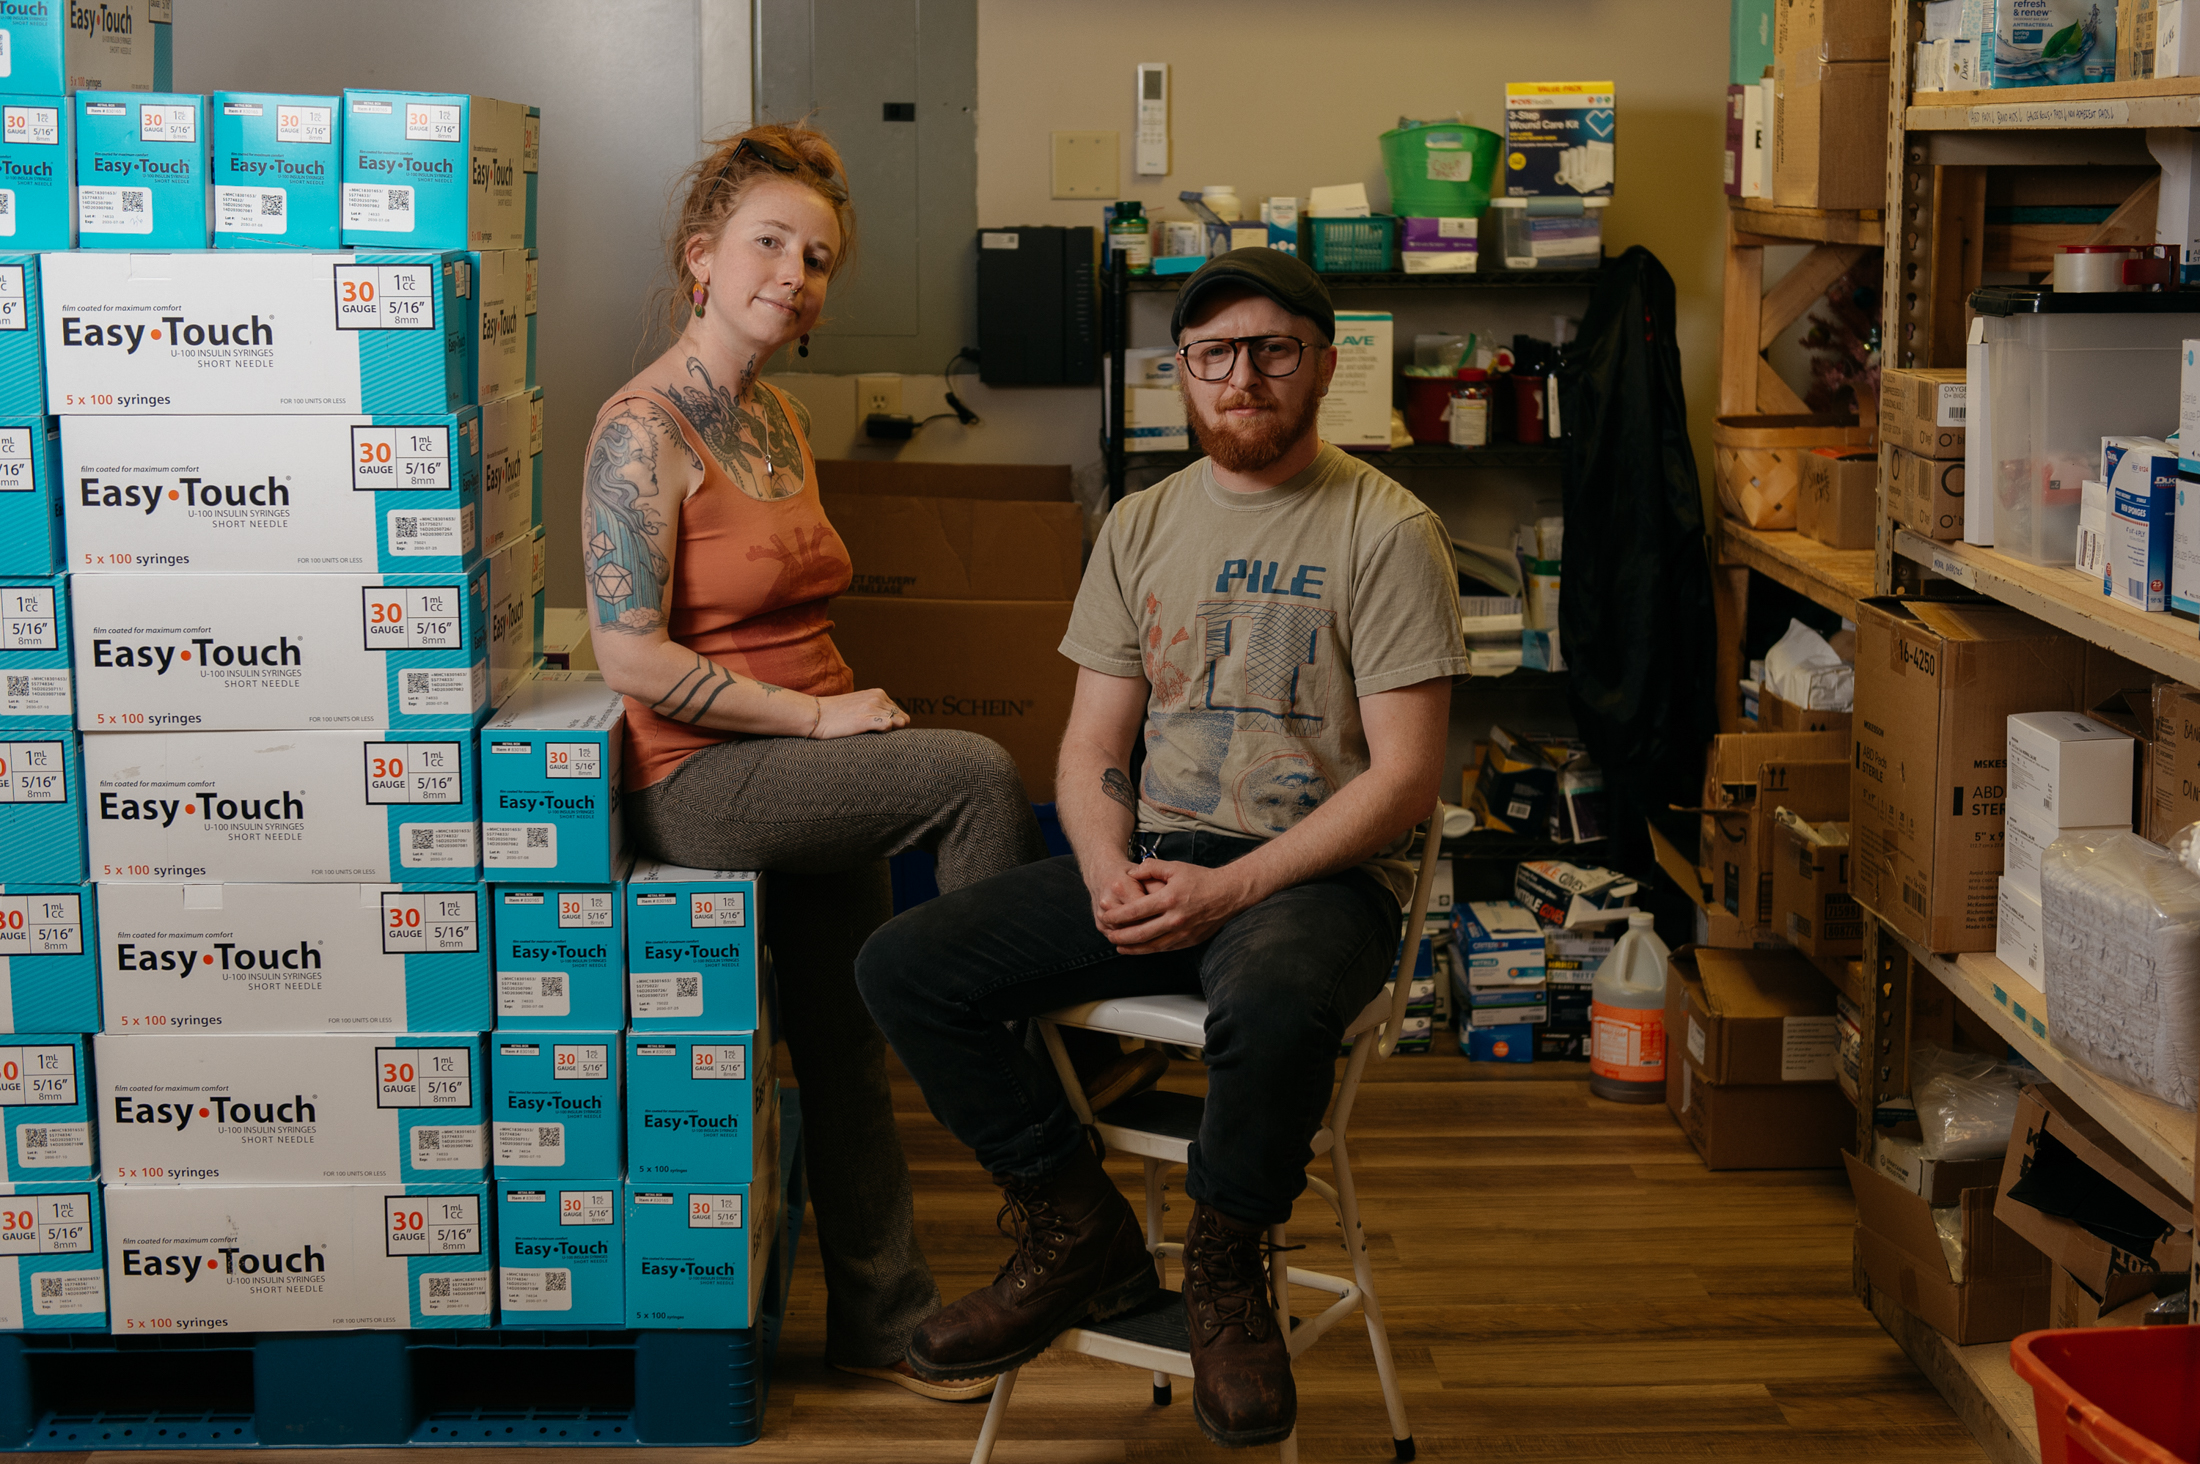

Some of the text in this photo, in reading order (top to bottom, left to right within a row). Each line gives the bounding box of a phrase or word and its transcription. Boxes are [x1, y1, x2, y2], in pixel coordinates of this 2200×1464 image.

[2013, 0, 2046, 8] refresh
[70, 1, 132, 38] Easy Touch
[1960, 58, 1969, 80] Dove
[144, 114, 163, 126] 30
[1508, 111, 1540, 121] 3-Step
[1508, 120, 1579, 130] Wound Care Kit
[94, 157, 190, 176] Easy Touch
[359, 155, 453, 174] Easy Touch
[402, 274, 416, 282] mL
[342, 281, 374, 302] 30
[402, 282, 416, 290] CC
[342, 304, 377, 313] GAUGE
[394, 316, 419, 324] 8mm
[62, 315, 274, 355] Easy Touch
[1332, 336, 1375, 346] AVE
[170, 349, 274, 357] U-100 INSULIN SYRINGES
[197, 360, 274, 368] SHORT NEEDLE
[66, 394, 171, 407] 5 x 100 syringes
[359, 442, 391, 463] 30
[359, 465, 393, 474] GAUGE
[80, 476, 290, 515] Easy Touch
[867, 575, 917, 586] DELIVERY
[1215, 559, 1327, 599] PILE
[858, 584, 903, 595] RELEASE
[370, 603, 402, 623] 30
[370, 625, 404, 634] GAUGE
[93, 636, 301, 676] Easy Touch
[1898, 639, 1935, 677] 16-4250
[200, 669, 302, 678] U-100 INSULIN SYRINGES
[942, 695, 1024, 717] SCHEIN
[1862, 745, 1888, 770] ABD Pads
[372, 758, 404, 778] 30
[1862, 761, 1884, 784] STERILE
[372, 780, 405, 789] GAUGE
[1972, 785, 2004, 799] ABD
[100, 790, 304, 828] Easy Touch
[500, 794, 595, 812] Easy Touch
[389, 908, 421, 927] 30
[1828, 905, 1856, 917] 71598
[389, 930, 422, 938] GAUGE
[1473, 941, 1509, 949] CRITERION
[117, 941, 322, 978] Easy Touch
[1547, 961, 1579, 969] HARDY
[383, 1063, 414, 1083] 30
[383, 1085, 416, 1093] GAUGE
[114, 1095, 316, 1131] Easy Touch
[392, 1211, 424, 1231] 30
[392, 1233, 425, 1241] GAUGE
[122, 1244, 325, 1284] Easy Touch
[641, 1262, 735, 1278] Easy Touch
[126, 1317, 228, 1330] 5 x 100 syringes
